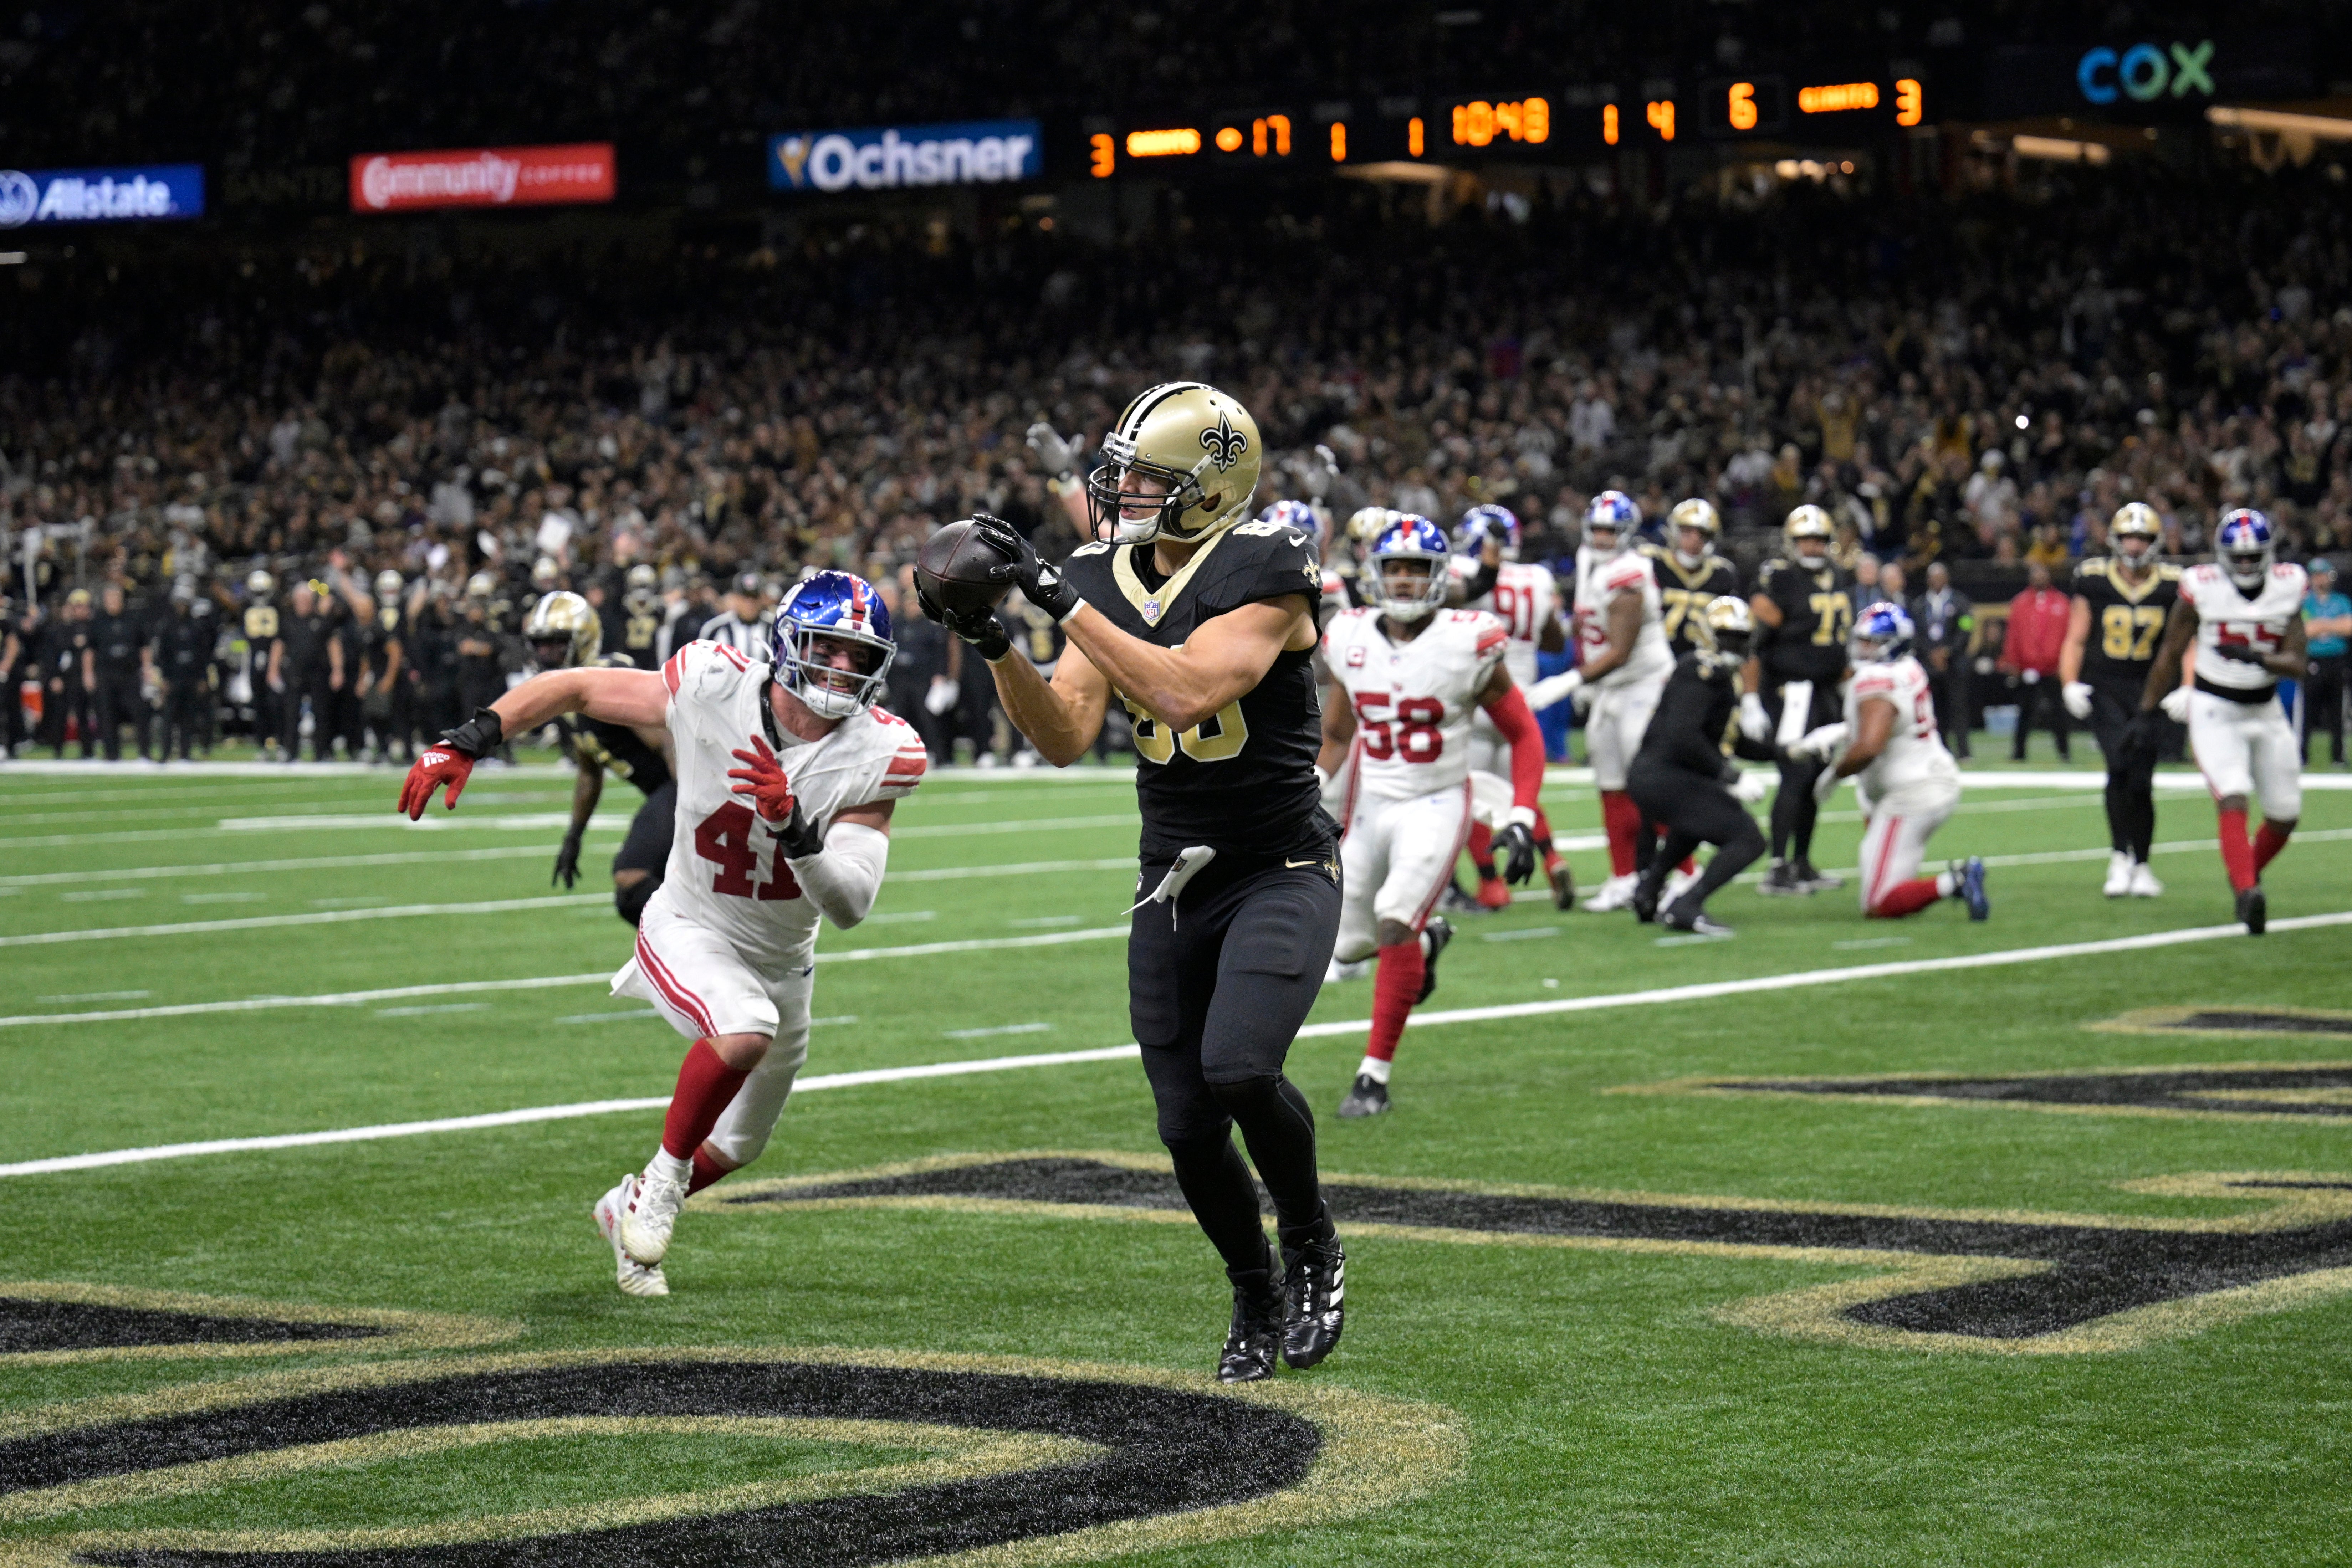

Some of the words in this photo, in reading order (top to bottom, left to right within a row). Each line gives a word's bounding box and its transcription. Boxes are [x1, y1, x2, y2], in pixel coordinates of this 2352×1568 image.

[2077, 40, 2215, 104] COX
[1647, 101, 1675, 140] 4
[1729, 83, 1757, 130] 6
[1896, 79, 1922, 126] 3
[808, 129, 1032, 192] Ochsner
[1091, 134, 1114, 177] 3
[36, 174, 170, 221] Allstate
[1146, 609, 1157, 617] NFL
[2101, 605, 2166, 661] 87
[1355, 692, 1443, 763] 58
[694, 800, 802, 901] 41
